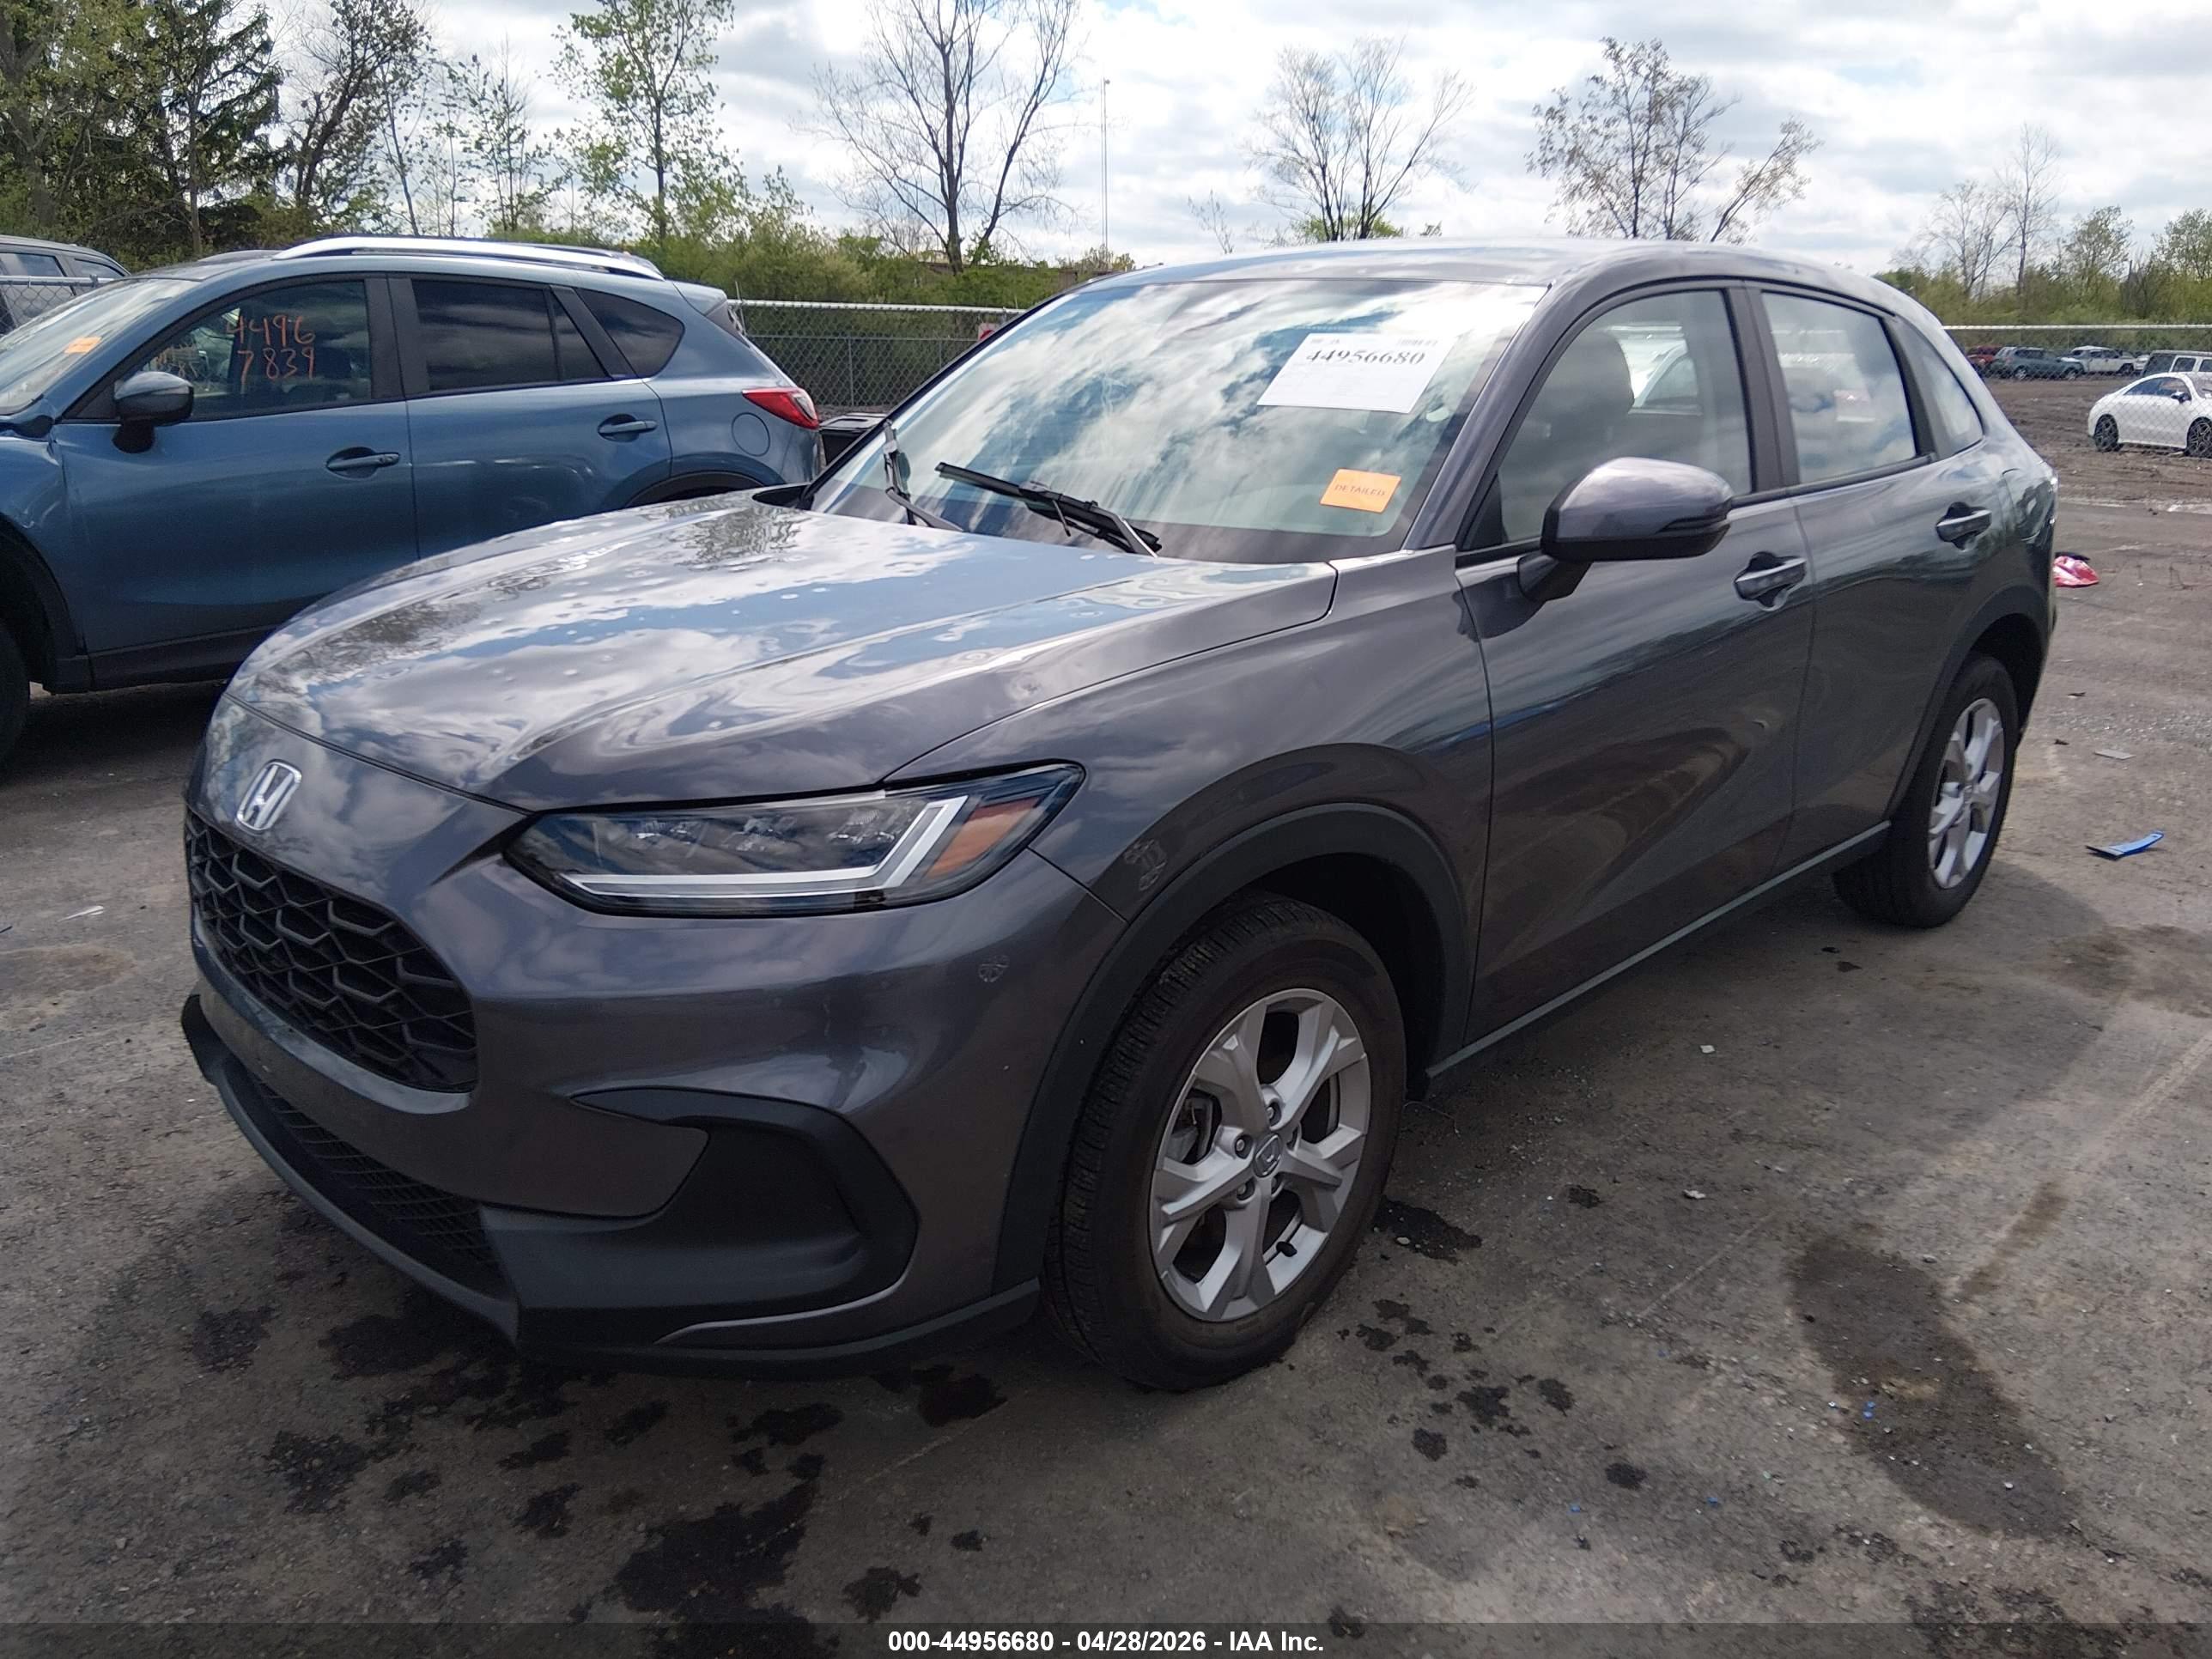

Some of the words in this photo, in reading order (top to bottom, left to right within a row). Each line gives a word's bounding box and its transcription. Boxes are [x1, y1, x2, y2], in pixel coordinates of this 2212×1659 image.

[225, 314, 315, 347] 4496
[237, 347, 315, 393] 7839
[1306, 349, 1426, 366] 44956680
[1334, 484, 1387, 497] DETAILED
